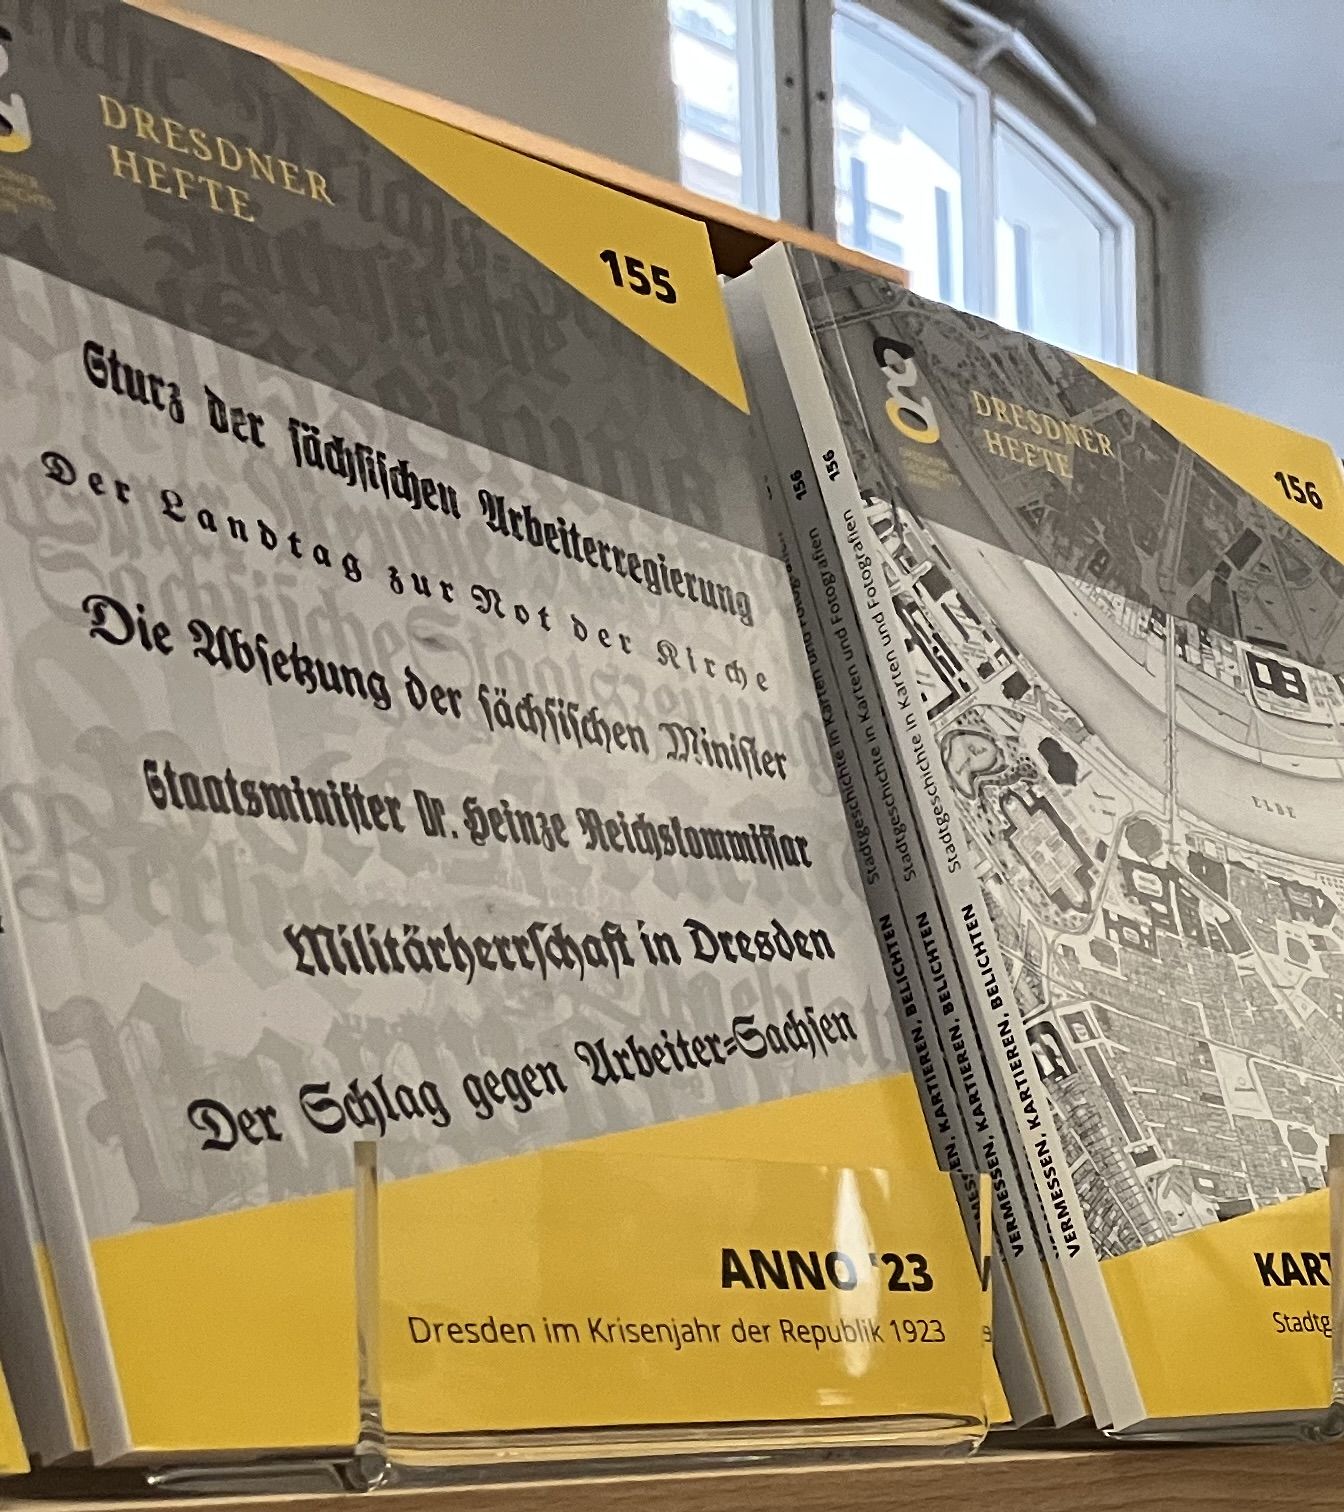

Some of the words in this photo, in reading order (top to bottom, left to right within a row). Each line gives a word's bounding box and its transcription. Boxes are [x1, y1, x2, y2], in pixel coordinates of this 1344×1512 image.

[98, 94, 335, 206] DRESDNER
[108, 144, 255, 222] HEFTE
[600, 249, 677, 305] 155
[822, 449, 840, 482] 156
[970, 390, 1115, 458] DRESDNER
[984, 430, 1074, 480] HEFTE
[83, 340, 184, 424] Sturz
[205, 385, 265, 448] der
[478, 489, 754, 627] Arbeiterregierung
[790, 469, 808, 501] 156
[1274, 472, 1323, 510] 156
[41, 451, 130, 504] Der
[388, 567, 453, 603] zur
[571, 614, 631, 655] der
[809, 527, 844, 625] Fotografien
[843, 509, 879, 609] Fotografien
[834, 626, 854, 662] und
[872, 612, 891, 647] und
[82, 595, 173, 655] Die
[188, 618, 392, 710] Absetzung
[405, 666, 461, 719] der
[659, 722, 788, 781] Minister
[847, 664, 870, 724] Karten
[885, 649, 909, 710] Karten
[904, 715, 918, 732] in
[865, 726, 877, 743] in
[144, 759, 405, 834] Staatsminister
[463, 796, 570, 852] Heinze
[832, 749, 880, 885] Stadtgeschichte
[870, 745, 917, 883] Stadtgeschichte
[911, 733, 961, 874] Stadtgeschichte
[1251, 796, 1296, 819] ELBE
[283, 922, 635, 985] Militärherrschaft
[637, 921, 682, 966] in
[688, 917, 836, 965] Dresden
[879, 914, 917, 1017] BELICHTEN
[916, 911, 955, 1016] BELICHTEN
[961, 903, 1003, 1010] BELICHTEN
[187, 1098, 283, 1152] Der
[300, 1075, 451, 1137] Schlag
[462, 1059, 568, 1121] gegen
[911, 1019, 950, 1133] KARTIEREN,
[949, 1018, 989, 1132] KARTIEREN,
[998, 1013, 1041, 1130] KARTIEREN,
[982, 1135, 1025, 1258] VERMESSEN,
[1034, 1133, 1081, 1258] VERMESSEN,
[720, 1247, 858, 1291] ANNO
[408, 1314, 536, 1345] Dresden
[544, 1316, 580, 1344] im
[589, 1316, 722, 1351] Krisenjahr
[732, 1318, 771, 1344] der
[782, 1319, 884, 1350] Republik
[889, 1319, 947, 1344] 1923
